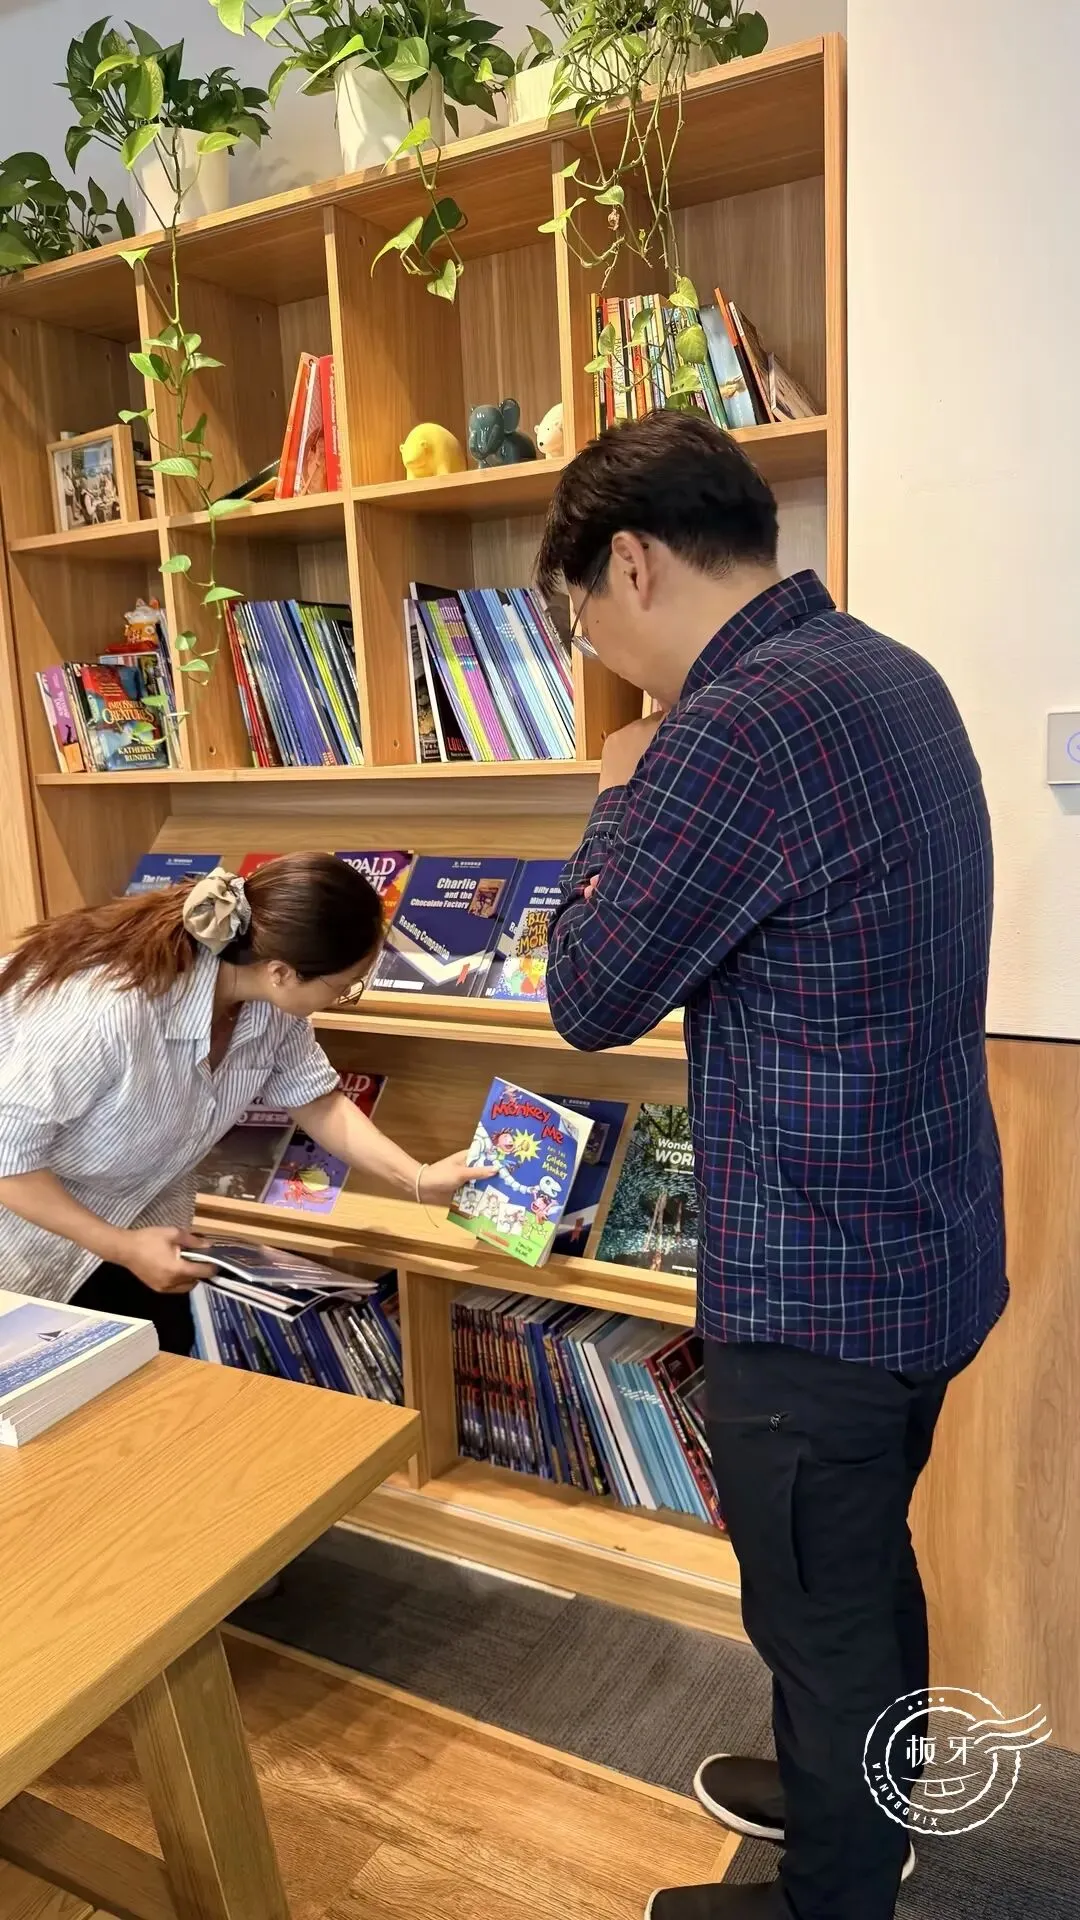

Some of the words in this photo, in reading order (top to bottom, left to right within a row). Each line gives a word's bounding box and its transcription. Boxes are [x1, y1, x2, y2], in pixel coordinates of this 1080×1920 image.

[102, 708, 155, 724] CREATURES
[436, 877, 477, 890] Charlie
[533, 886, 550, 895] Billy
[444, 891, 459, 899] and
[459, 891, 473, 900] the
[529, 897, 546, 905] Mini
[410, 898, 443, 908] Chocolate
[443, 900, 470, 910] Factory
[527, 911, 550, 926] BILL
[529, 924, 548, 936] MIN
[399, 915, 421, 940] Reading
[420, 931, 451, 961] Companion
[519, 934, 548, 953] MON
[491, 1099, 552, 1123] Monkey
[658, 1137, 694, 1152] Wonde
[541, 1161, 568, 1180] Monkey
